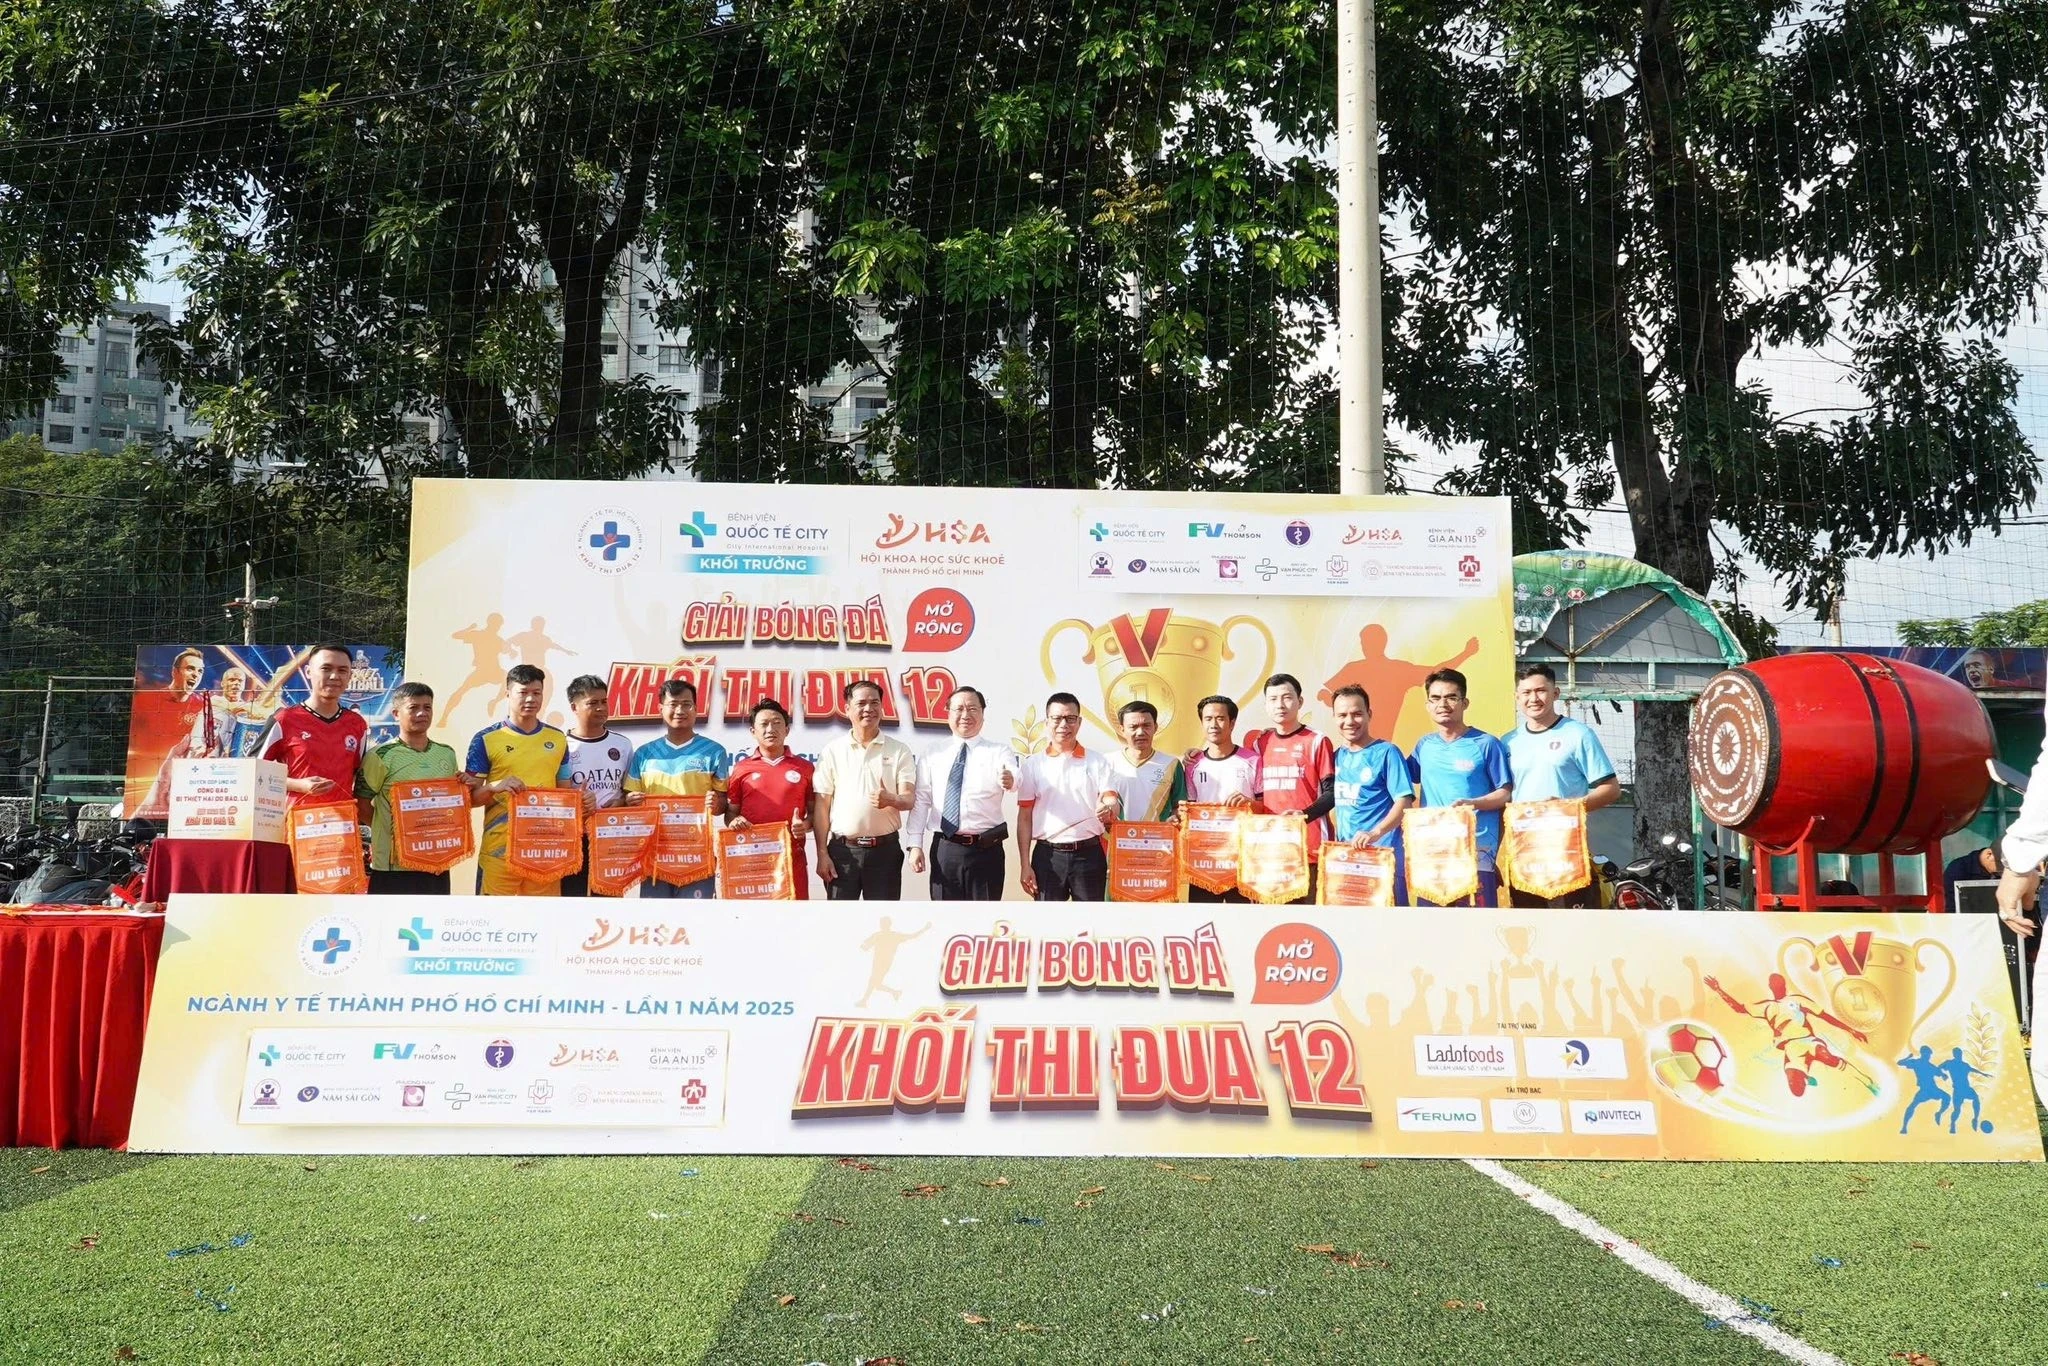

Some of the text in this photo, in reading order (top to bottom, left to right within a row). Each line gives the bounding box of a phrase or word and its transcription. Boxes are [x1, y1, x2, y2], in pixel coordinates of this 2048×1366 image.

[725, 523, 829, 540] QUỐC TẾ CITY
[925, 519, 991, 545] HSA
[1148, 530, 1166, 538] CITY
[1188, 522, 1225, 538] FV
[1368, 527, 1403, 541] HSA
[1428, 534, 1477, 544] GIA AN 115
[700, 555, 808, 571] KHỐI TRƯỞNG
[860, 552, 881, 565] HỘI
[884, 554, 917, 564] KHOA
[920, 555, 945, 566] HỌC
[947, 553, 970, 565] SỨC
[1150, 564, 1201, 574] NAM SÀI GÒN
[924, 601, 954, 616] MỞ
[683, 591, 892, 648] GIẢI BÓNG ĐÁ
[914, 620, 963, 636] RỘNG
[900, 666, 958, 728] 12
[441, 928, 538, 943] QUỐC TẾ CITY
[629, 924, 691, 947] HSA
[1277, 940, 1315, 960] MỞ
[414, 957, 516, 972] KHỐI TRƯỞNG
[589, 956, 619, 965] KHOA
[623, 956, 646, 967] HỌC
[649, 955, 671, 966] SỨC
[939, 919, 1235, 998] GIẢI BÓNG ĐÁ
[662, 969, 683, 977] MINH
[1264, 963, 1329, 986] RỘNG
[187, 993, 268, 1012] NGÀNH
[275, 997, 289, 1012] Y
[295, 991, 324, 1012] TẾ
[327, 992, 405, 1012] THÀNH
[411, 992, 459, 1013] PHỐ
[464, 993, 498, 1013] HỒ
[503, 994, 544, 1013] CHÍ
[548, 998, 605, 1014] MINH
[625, 994, 669, 1015] LẦN
[674, 1000, 683, 1015] 1
[689, 997, 739, 1015] NĂM
[745, 1001, 795, 1016] 2025
[326, 1053, 346, 1061] CITY
[373, 1043, 456, 1061] FV THOMSON
[1426, 1043, 1505, 1063] Ladofoods
[649, 1055, 706, 1065] GIA AN 115
[792, 1002, 1373, 1122] KHỐI THI ĐUA 12
[322, 1094, 343, 1102] NAM
[360, 1092, 381, 1102] GÒN
[1411, 1112, 1477, 1122] TERUMO
[1597, 1110, 1642, 1121] INVITECH
